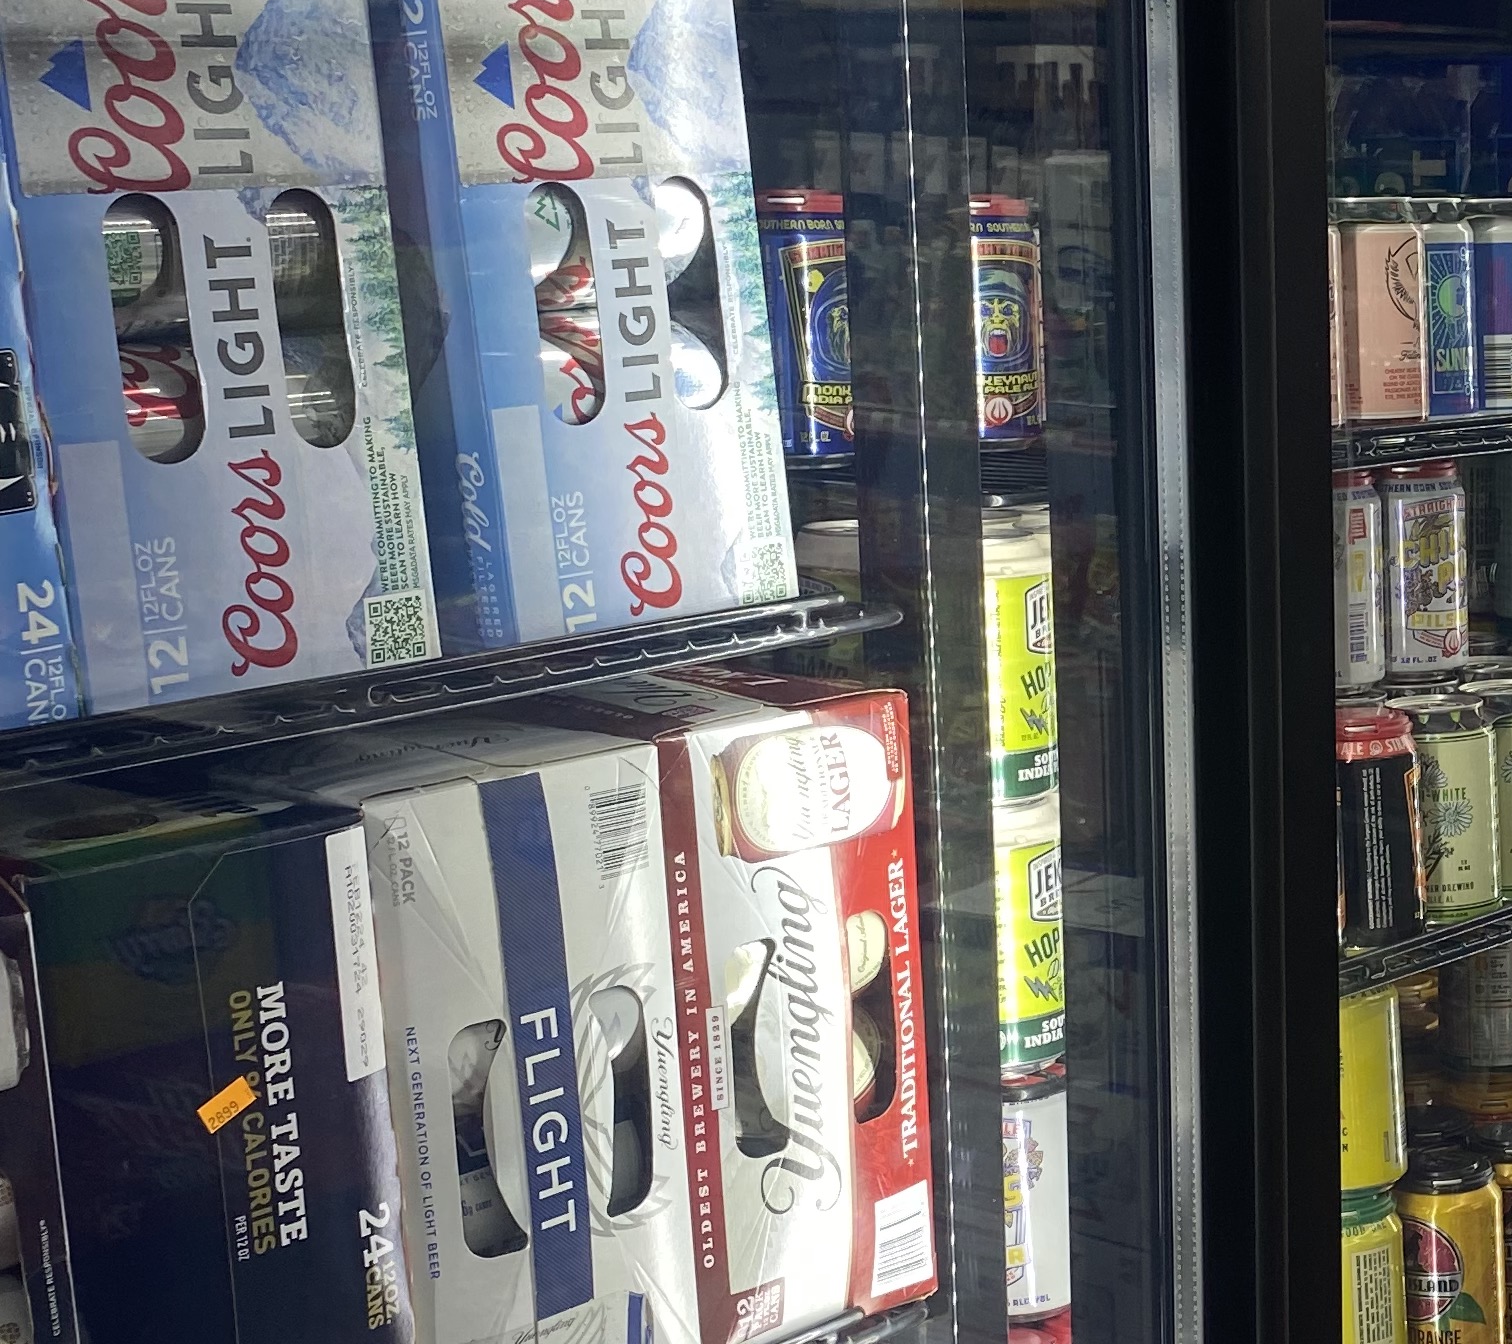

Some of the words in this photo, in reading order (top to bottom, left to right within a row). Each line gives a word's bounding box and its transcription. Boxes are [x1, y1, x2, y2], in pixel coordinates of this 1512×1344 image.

[404, 42, 429, 121] CANS
[203, 234, 277, 440] LIGHT
[605, 219, 661, 404] LIGHT
[362, 416, 377, 463] MAKING
[372, 485, 387, 558] COMMITTING
[389, 473, 399, 502] HOW
[394, 505, 405, 542] LEARN
[455, 451, 492, 551] Cold
[620, 412, 682, 616] Coors
[221, 448, 299, 678] Coors
[386, 535, 397, 563] MORE
[563, 491, 590, 567] CANS
[17, 580, 60, 645] 24
[155, 536, 185, 622] CANS
[388, 565, 399, 591] BEER
[563, 579, 597, 633] 12
[148, 633, 190, 696] 12
[826, 732, 851, 834] LAGER
[1340, 741, 1364, 756] ALE
[396, 830, 411, 850] 12
[398, 857, 416, 905] PACK
[674, 851, 694, 974] AMERICA
[887, 857, 911, 954] LAGER
[229, 990, 259, 1066] ONLY
[685, 988, 699, 1017] IN
[711, 1015, 722, 1050] 1829
[257, 980, 297, 1106] MORE
[404, 1025, 420, 1066] NEXT
[751, 866, 842, 1216] Yuengling
[890, 955, 919, 1159] TRADITIONAL
[207, 1099, 240, 1132] 2899
[650, 1016, 679, 1150] Yuengling
[687, 1029, 707, 1154] BREWERY
[709, 1058, 725, 1101] SINCE
[411, 1070, 429, 1164] GENERATION
[519, 1006, 577, 1232] FLIGHT
[240, 1112, 276, 1255] CALORIES
[269, 1112, 308, 1247] TASTE
[422, 1193, 436, 1239] LIGHT
[358, 1202, 393, 1268] 24
[696, 1169, 715, 1269] OLDEST
[427, 1242, 441, 1280] BEER
[45, 1283, 61, 1337] CELEBRATE
[365, 1268, 386, 1331] CANS
